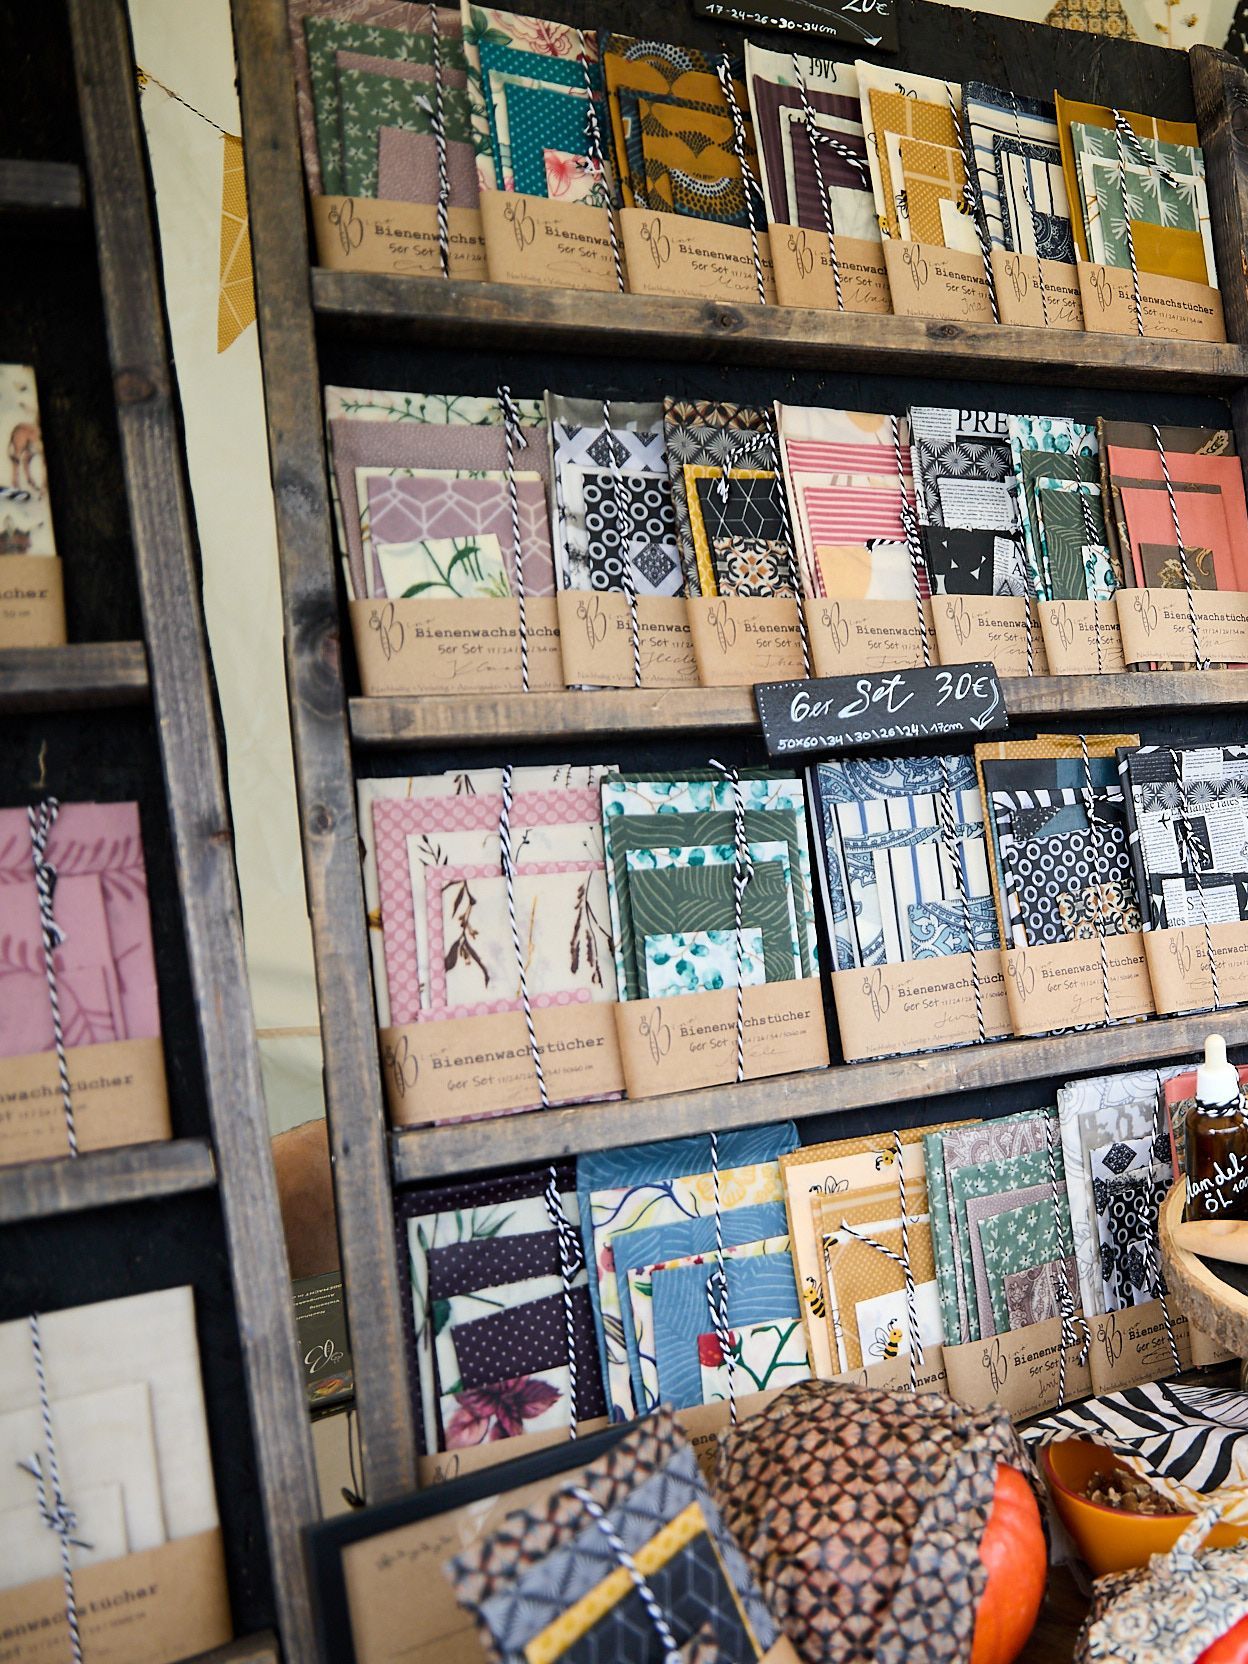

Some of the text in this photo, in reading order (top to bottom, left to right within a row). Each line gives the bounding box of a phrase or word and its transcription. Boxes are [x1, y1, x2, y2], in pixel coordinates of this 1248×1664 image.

[374, 224, 486, 246] Bienenwchst
[544, 225, 625, 250] Bienenwah
[1032, 280, 1081, 297] Benenwa
[415, 626, 560, 638] Bienenwachsüche
[1187, 625, 1200, 634] St
[627, 637, 646, 647] 5r
[1087, 636, 1098, 645] 5e
[790, 671, 989, 723] 6er Set 30€
[1041, 956, 1145, 979] Bienenwachtücher
[680, 1010, 811, 1038] Bienenwchstücher
